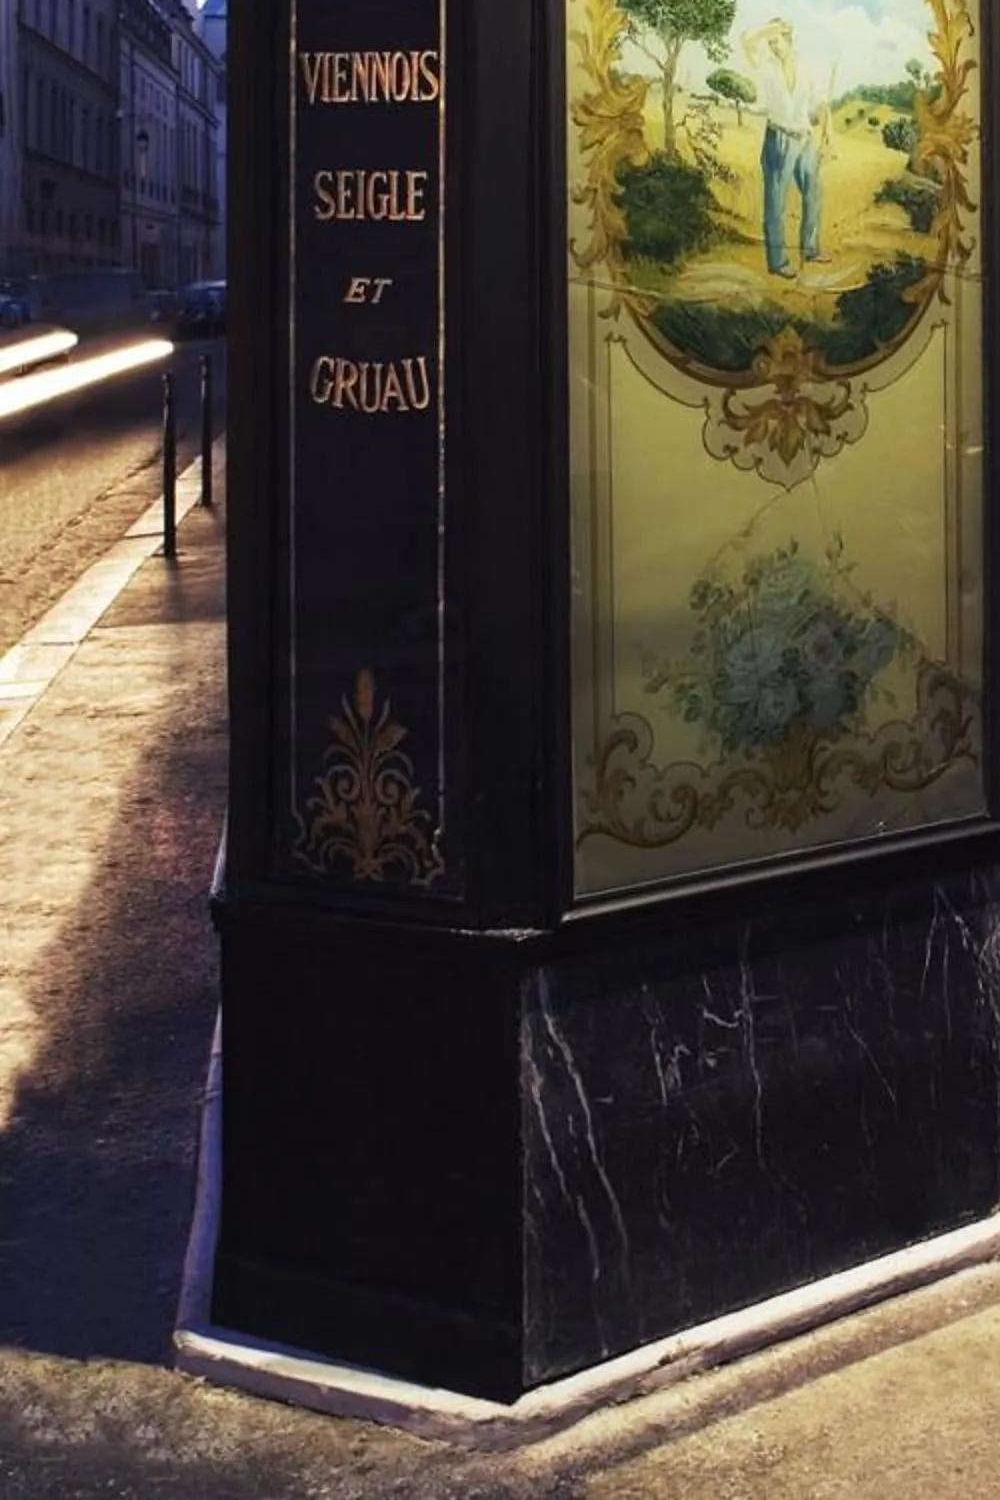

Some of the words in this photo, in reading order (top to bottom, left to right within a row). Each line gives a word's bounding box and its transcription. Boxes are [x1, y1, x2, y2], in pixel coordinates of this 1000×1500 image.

[301, 51, 439, 104] VIENNOIS
[315, 171, 426, 221] SEIGLE
[344, 278, 392, 303] ET
[309, 356, 430, 413] GRUAU
